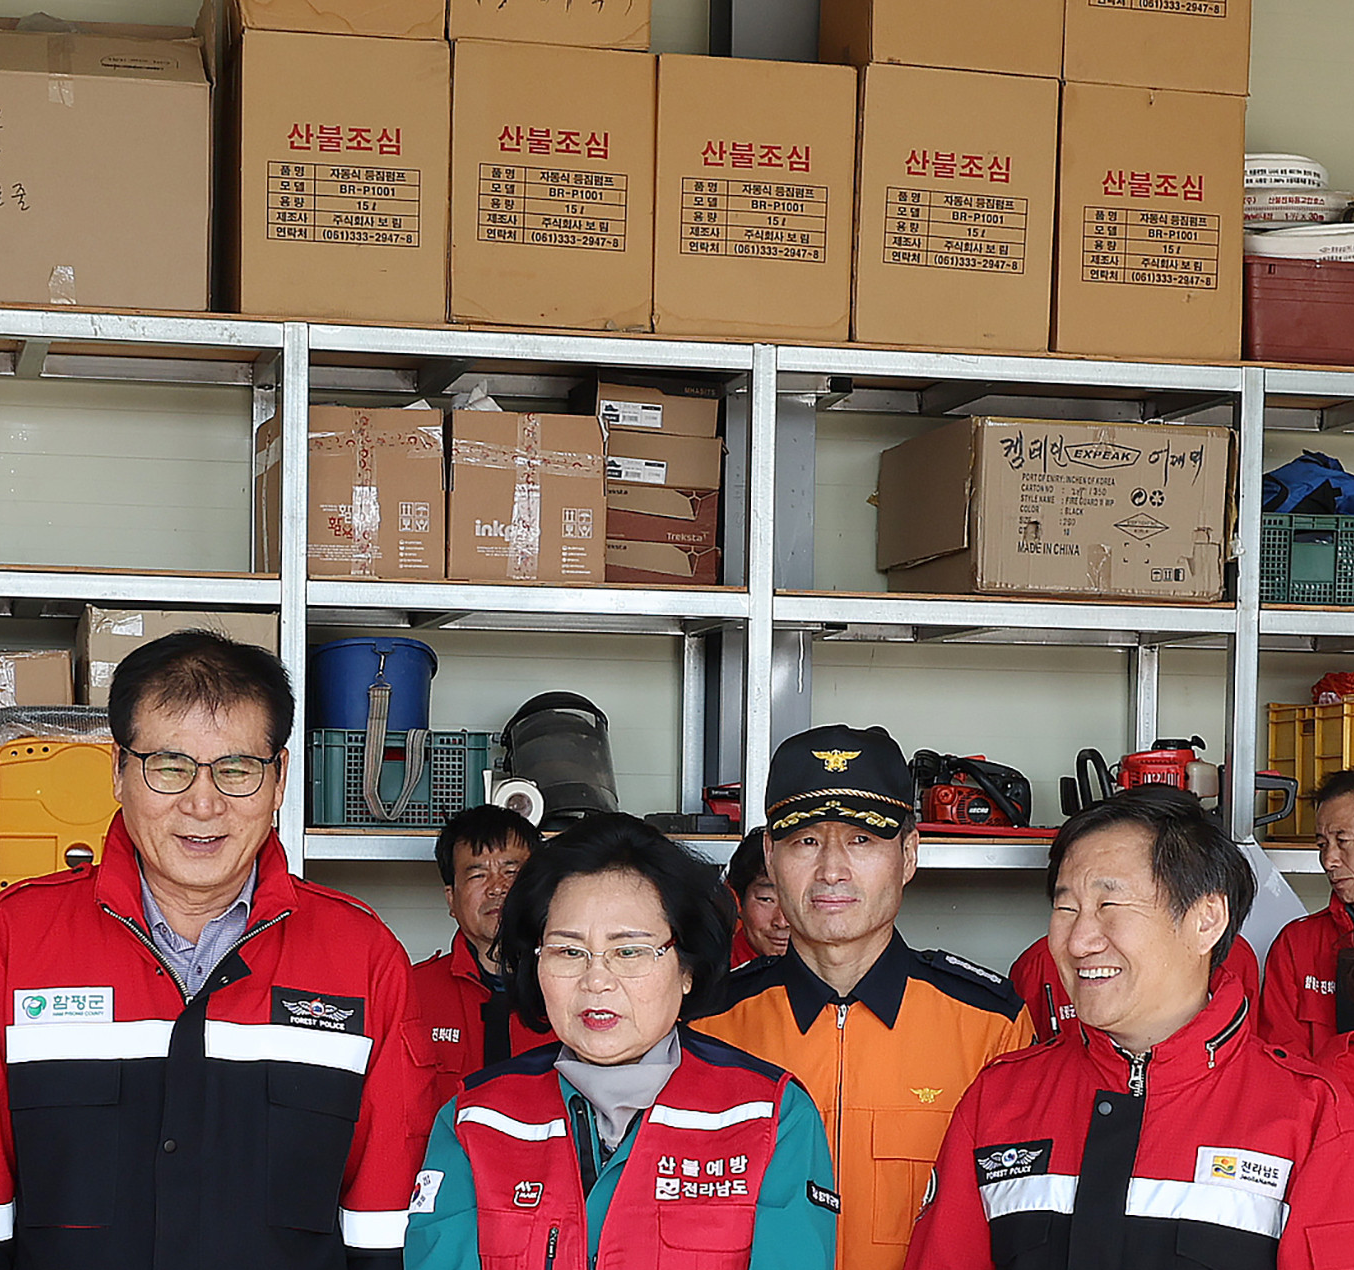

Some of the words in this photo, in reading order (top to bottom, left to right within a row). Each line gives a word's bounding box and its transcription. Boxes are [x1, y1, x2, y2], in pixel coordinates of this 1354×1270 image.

[287, 123, 402, 156] 산불조심
[498, 124, 609, 159] 산불조심
[701, 140, 811, 172] 산불조심
[905, 148, 1012, 182] 산불조심
[330, 168, 361, 182] 자동식
[540, 171, 570, 184] 자동식
[339, 185, 395, 197] BR-P1001
[742, 184, 771, 196] 자동식
[1102, 169, 1205, 202] 산불조심
[11, 183, 29, 210] 줄
[549, 187, 603, 200] BR-P1001
[751, 200, 804, 213] BR-P1001
[944, 195, 972, 208] 자동식
[276, 212, 308, 224] 제조사
[333, 214, 375, 228] 주식회사
[487, 213, 517, 226] 제조사
[541, 218, 581, 230] 주식회사
[951, 211, 1004, 224] BR-P1001
[1140, 213, 1167, 226] 자동식
[276, 226, 308, 239] 연락처
[487, 228, 517, 240] 연락처
[689, 226, 719, 238] 제조사
[744, 229, 783, 242] 주식회사
[1148, 229, 1199, 242] BR-P1001
[689, 240, 719, 253] 연락처
[893, 236, 921, 248] 제조사
[944, 240, 983, 254] 주식회사
[892, 250, 921, 264] 연락처
[1089, 255, 1119, 267] 제조사
[1141, 258, 1178, 272] 주식회사
[1089, 269, 1119, 282] 연락처
[1074, 450, 1131, 460] EXPEAK
[667, 532, 703, 542] Treksta
[1018, 542, 1041, 554] MADE
[1043, 543, 1052, 554] IN
[1053, 544, 1080, 556] CHINA
[53, 995, 104, 1010] 함평군
[290, 1016, 317, 1025] FOREST
[319, 1020, 345, 1030] POLICE
[657, 1155, 747, 1177] 산불예방
[986, 1168, 1007, 1180] FOREST
[1010, 1165, 1031, 1177] POLICE
[1241, 1160, 1279, 1179] 전라남도
[681, 1178, 748, 1198] 전라남도
